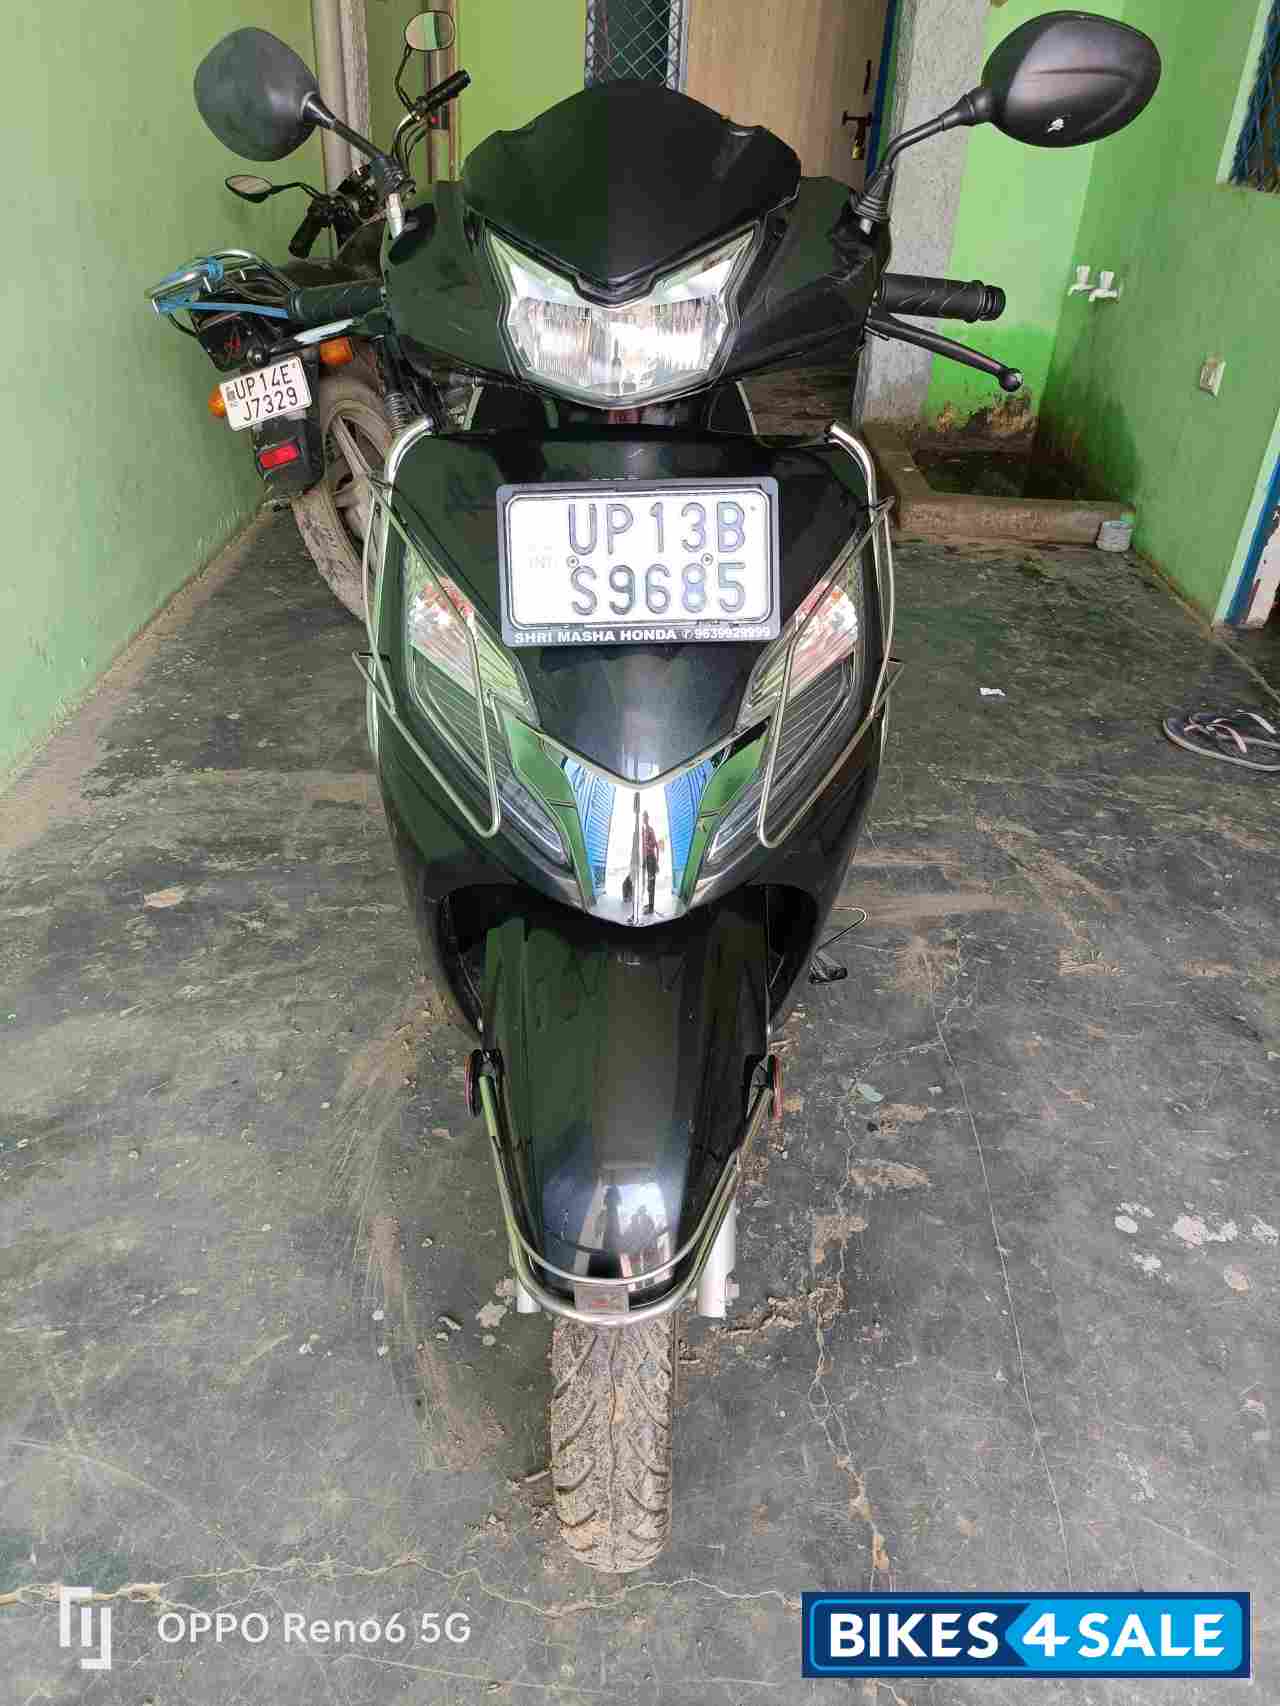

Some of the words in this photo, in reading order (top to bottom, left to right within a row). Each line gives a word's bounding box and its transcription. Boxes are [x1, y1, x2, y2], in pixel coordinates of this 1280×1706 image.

[234, 364, 292, 400] UP14E
[243, 386, 298, 421] J7329
[568, 501, 745, 555] UP13B
[570, 561, 746, 616] S9685
[514, 631, 553, 643] SHRI
[557, 629, 616, 642] MASHA
[620, 628, 677, 641] HONDA
